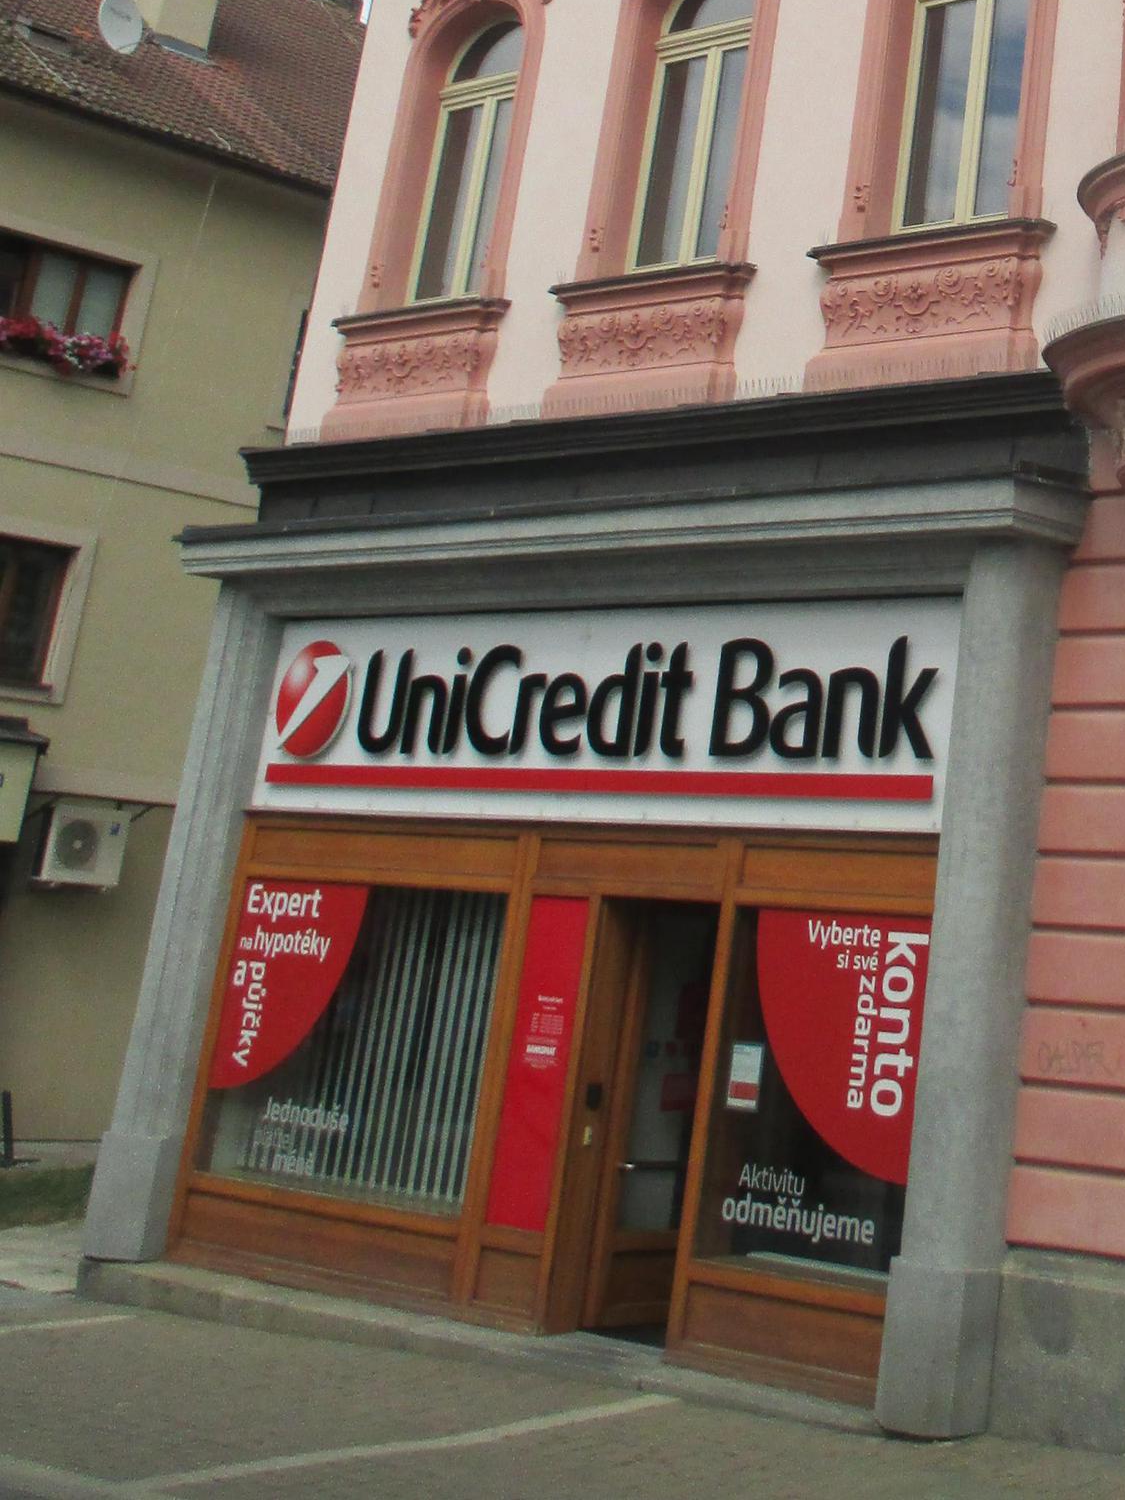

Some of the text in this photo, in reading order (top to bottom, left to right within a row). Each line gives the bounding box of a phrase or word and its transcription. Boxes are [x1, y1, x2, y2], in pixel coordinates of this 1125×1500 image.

[357, 635, 939, 760] UniCredit Bank
[247, 883, 322, 923] Expert
[240, 925, 331, 962] na hypotéky
[808, 919, 881, 949] Vyberte
[836, 950, 878, 971] si své
[232, 960, 267, 1067] a půjčky
[870, 931, 929, 1117] konto
[847, 975, 878, 1109] zdarma
[738, 1163, 806, 1196] Aktivitu
[721, 1192, 875, 1245] odměňujeme
